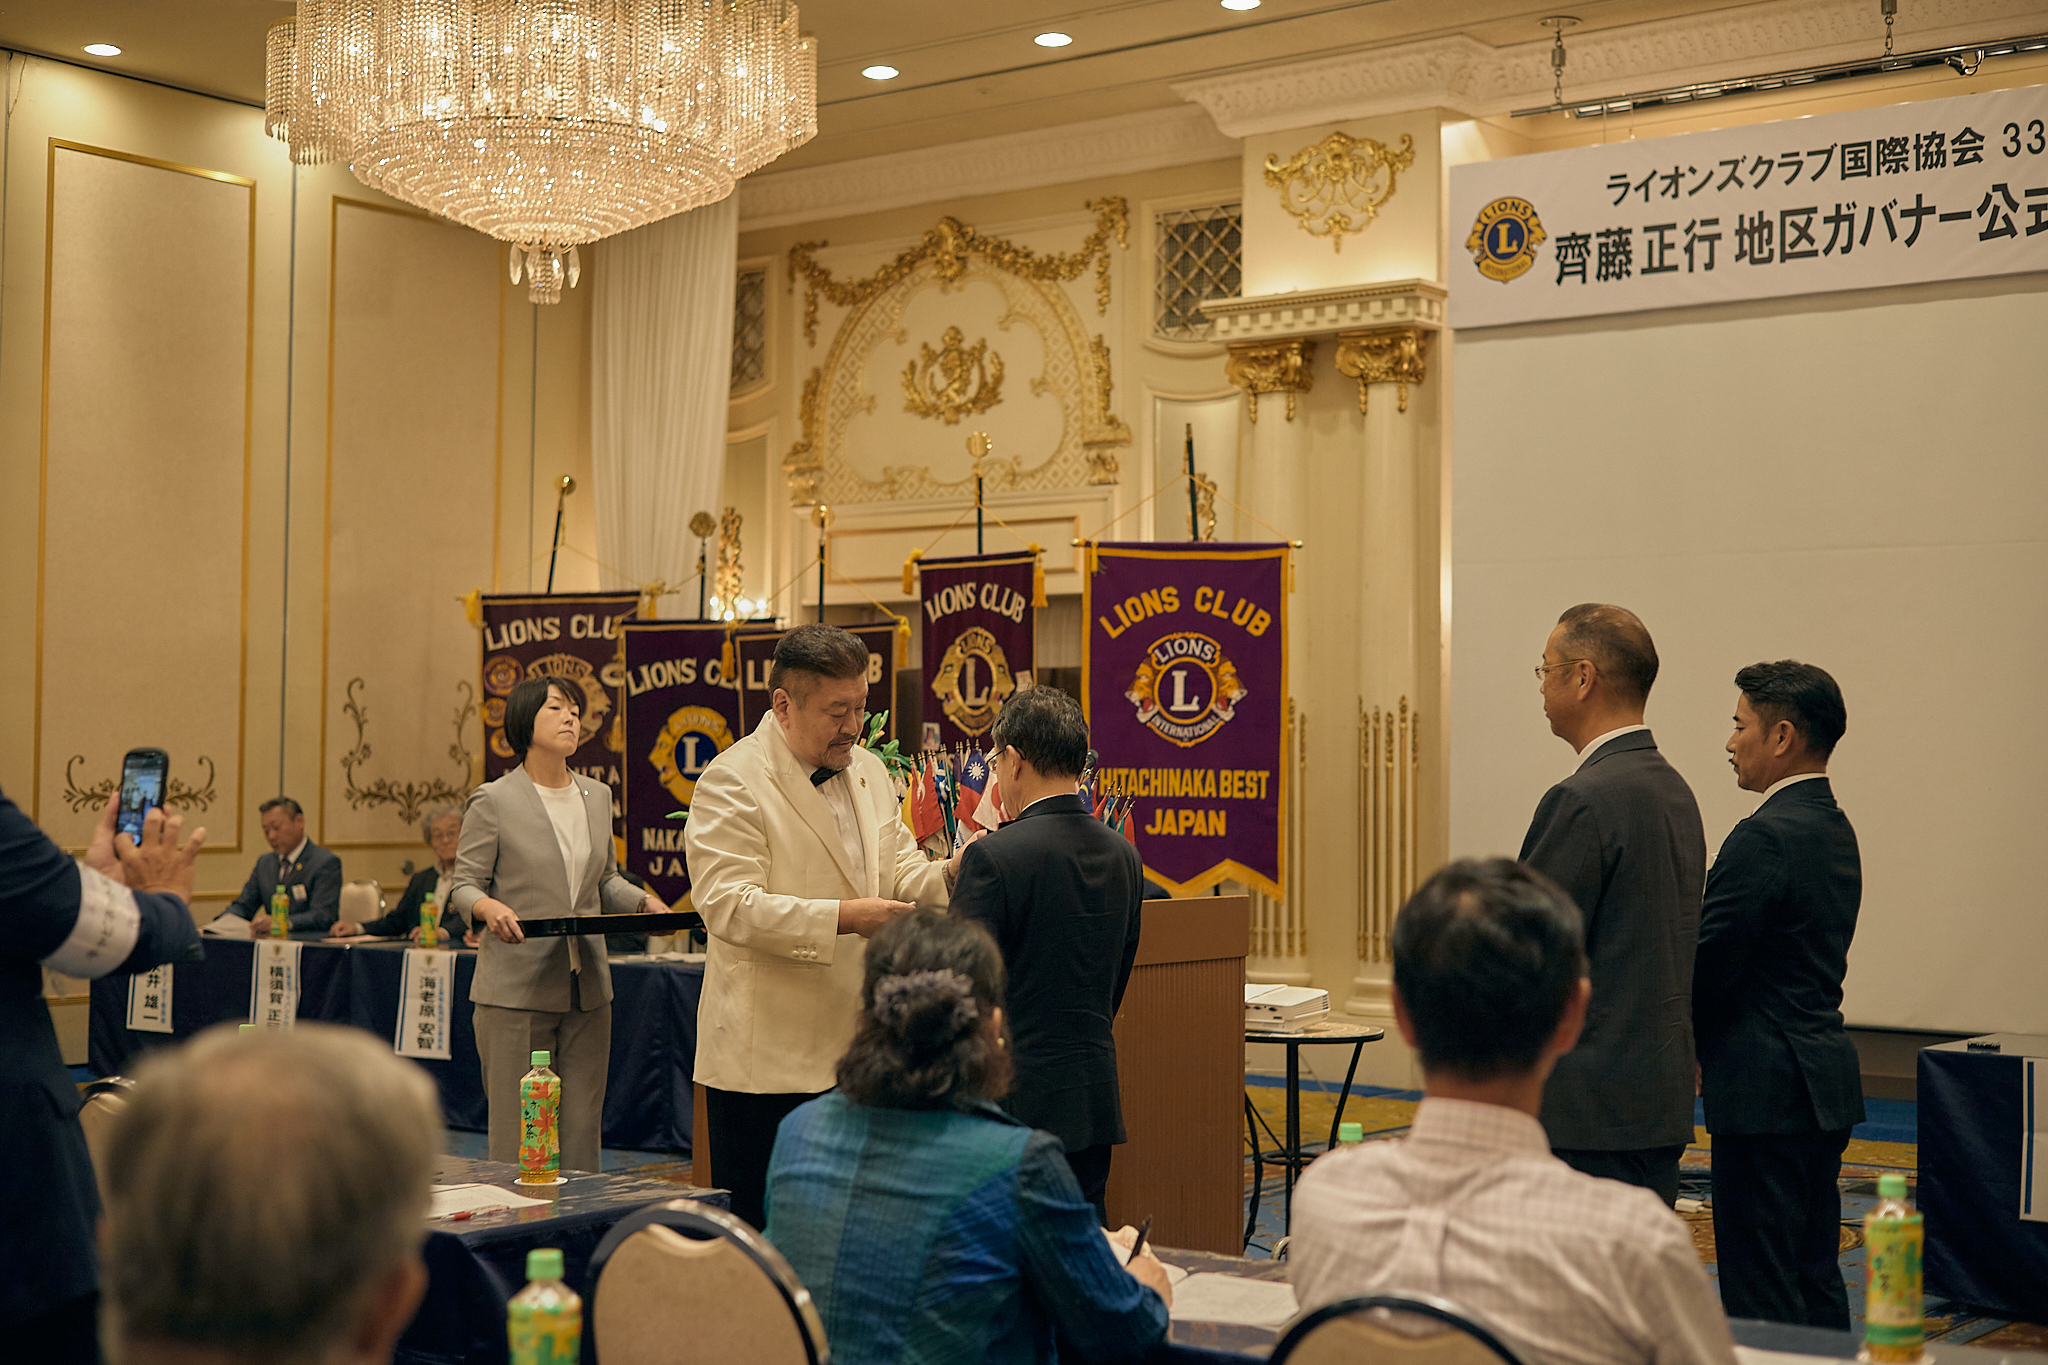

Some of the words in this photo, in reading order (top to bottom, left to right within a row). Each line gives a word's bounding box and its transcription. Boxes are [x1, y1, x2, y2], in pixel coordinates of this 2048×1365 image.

[1606, 126, 1986, 206] ライオンズクラブ国際協会
[1484, 201, 1530, 219] LIONS
[1496, 223, 1518, 253] L
[924, 581, 977, 624] LIONS
[980, 582, 1026, 624] CLUB
[1099, 585, 1180, 639] LIONS
[1194, 586, 1272, 637] CLUB
[484, 616, 561, 652] LIONS
[570, 613, 618, 641] CLU
[960, 633, 991, 654] LIONS
[1154, 638, 1215, 663] LIONS
[626, 657, 697, 697] LIONS
[965, 657, 989, 706] L
[1169, 670, 1200, 711] L
[1151, 714, 1220, 738] INTERNATIONAL
[682, 736, 710, 775] L
[1099, 767, 1217, 798] HITACHINAKA
[1219, 769, 1271, 799] BEST
[1145, 808, 1227, 837] JAPAN
